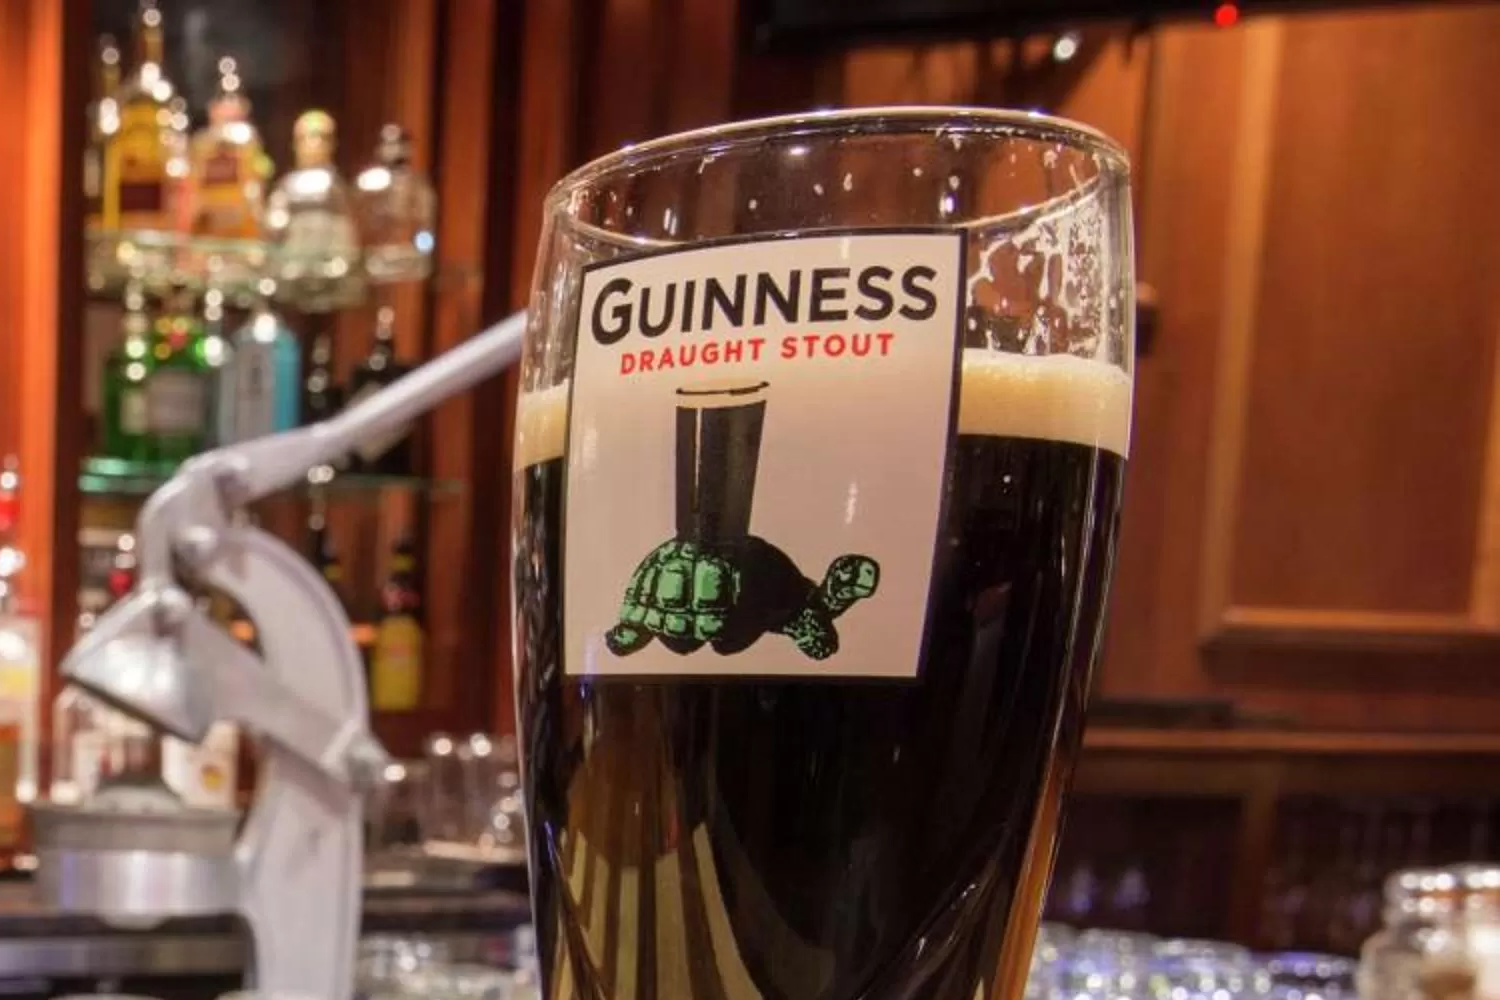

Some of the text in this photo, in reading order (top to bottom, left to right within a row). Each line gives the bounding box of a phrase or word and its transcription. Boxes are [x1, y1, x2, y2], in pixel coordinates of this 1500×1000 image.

[591, 265, 938, 346] GUINNESS
[619, 332, 895, 376] DRAUGHT STOUT
